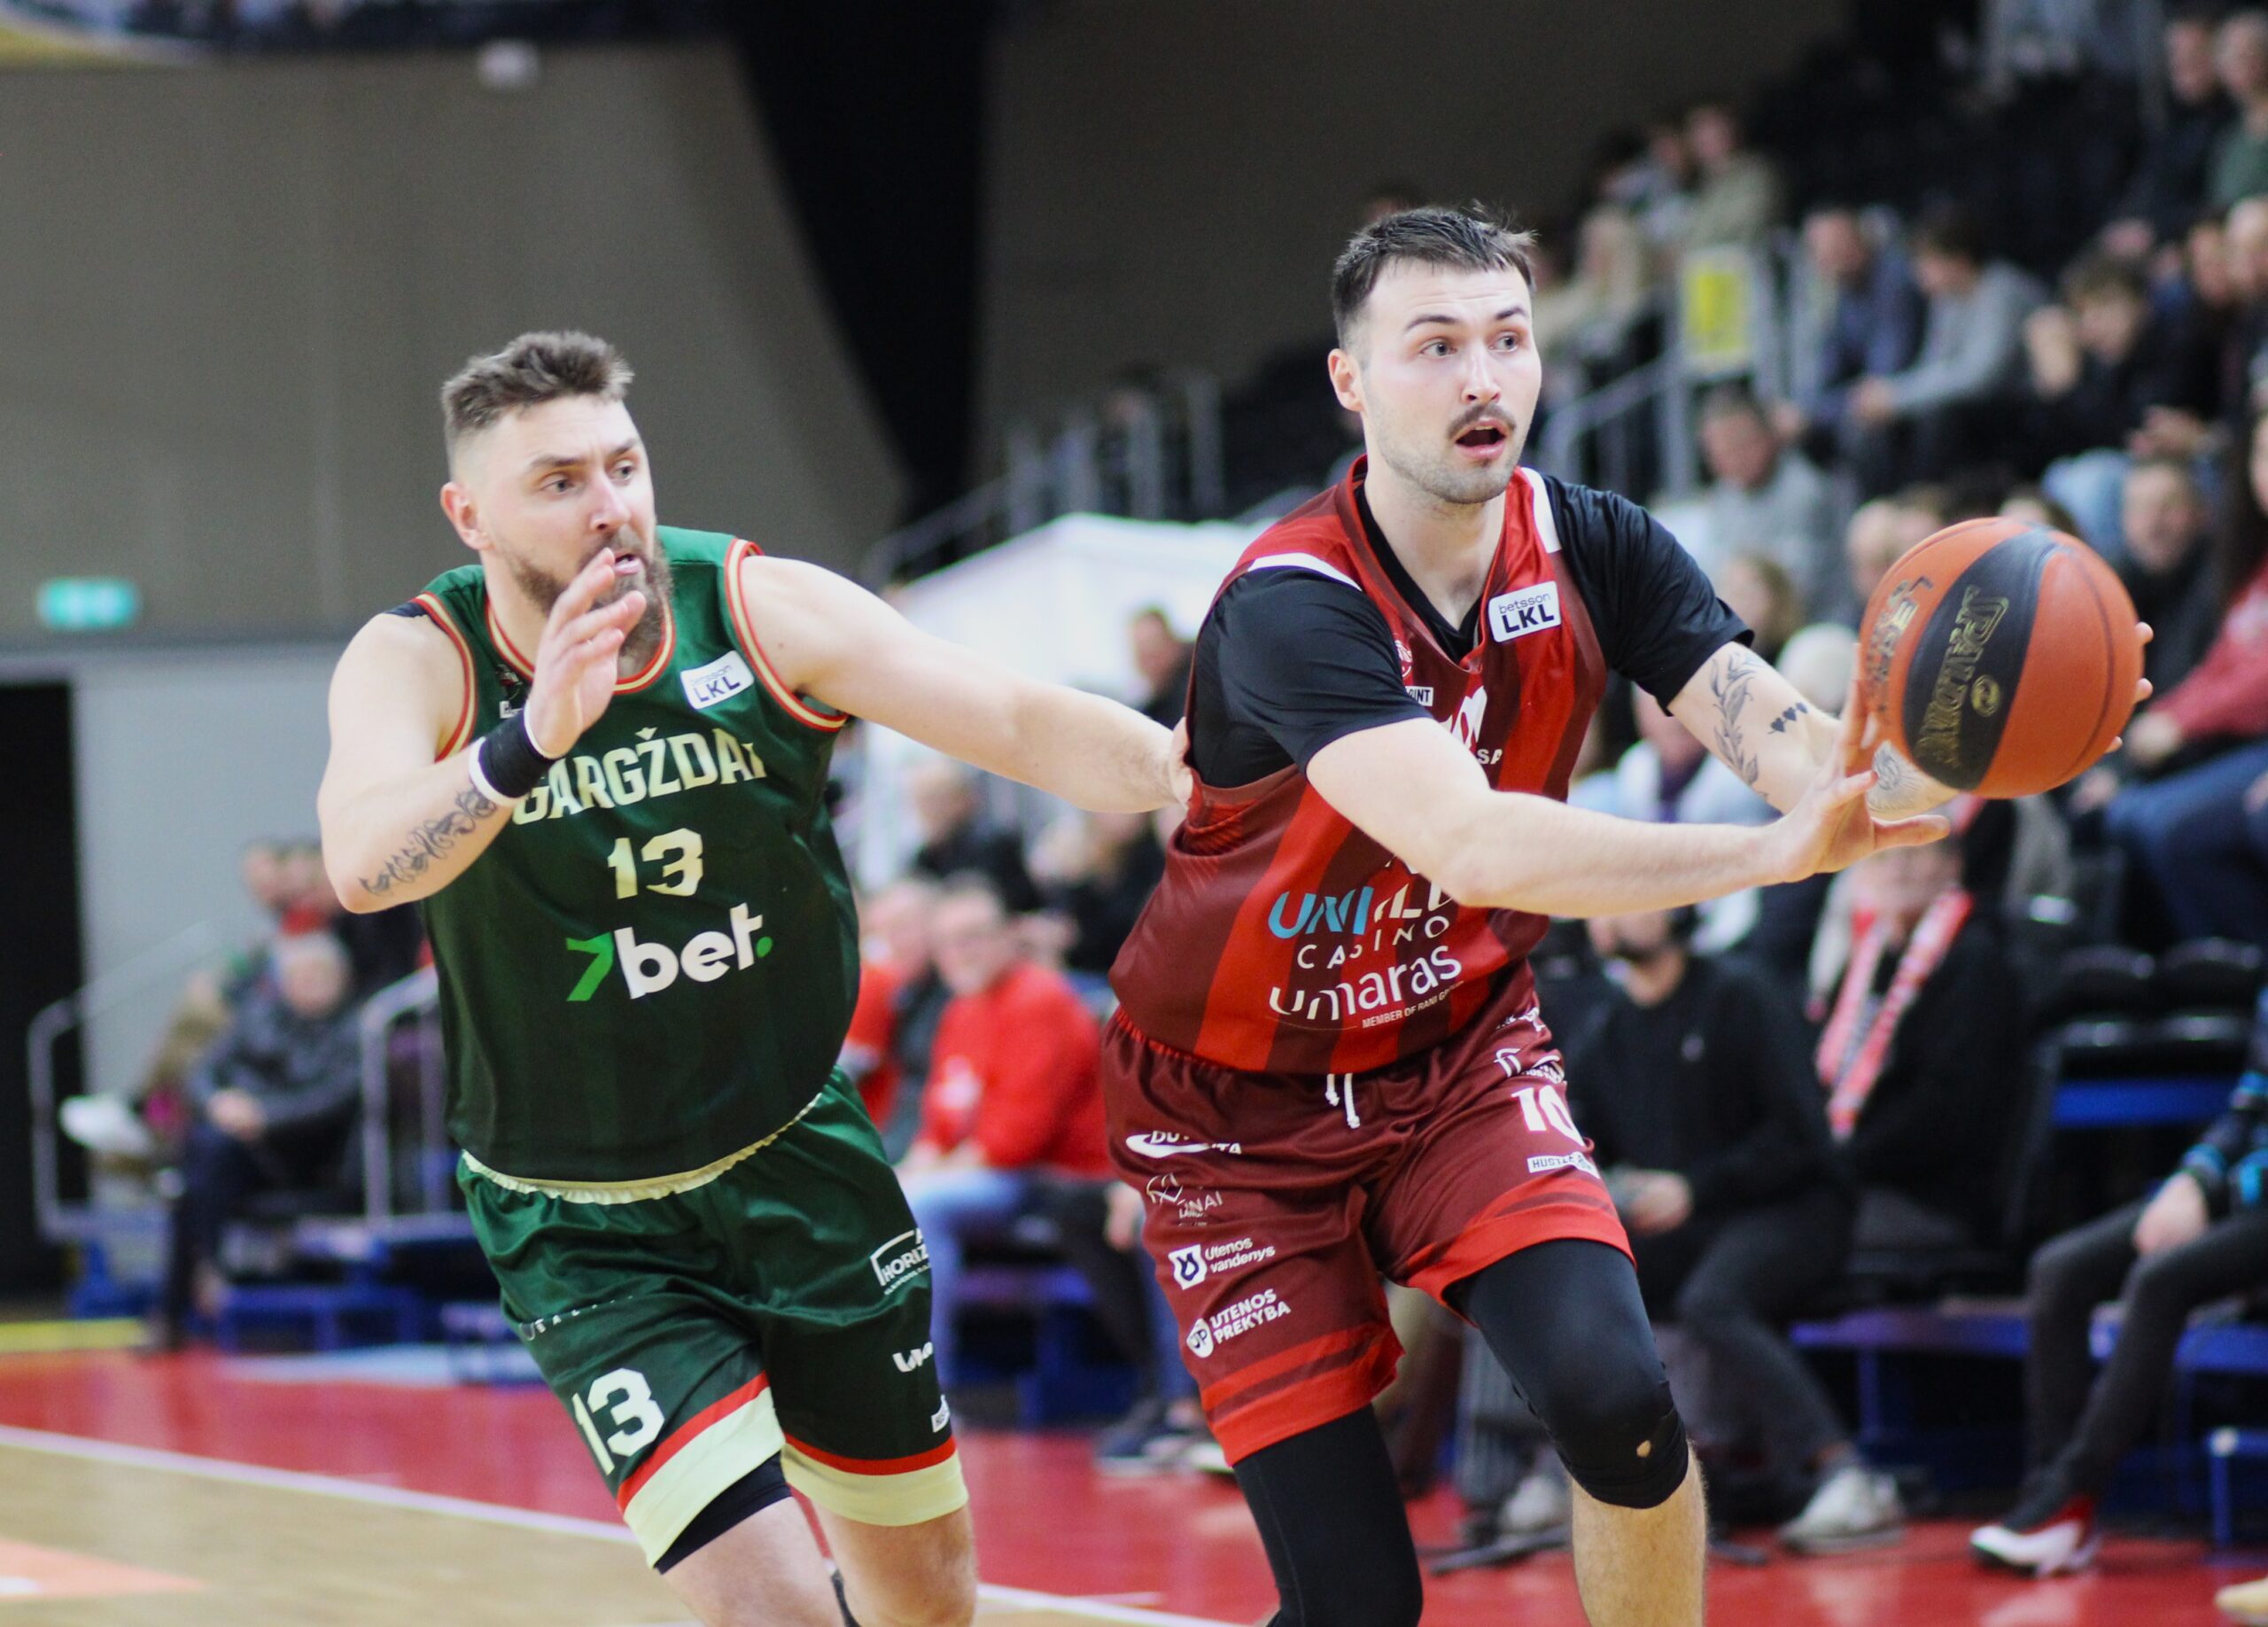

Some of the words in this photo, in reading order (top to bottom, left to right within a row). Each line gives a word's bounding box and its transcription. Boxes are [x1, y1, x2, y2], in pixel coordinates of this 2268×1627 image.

[1498, 593, 1551, 614] betsson
[1502, 603, 1555, 633] LKL
[693, 676, 742, 702] LKL
[607, 828, 703, 899] 13
[1511, 1085, 1586, 1148] 10
[1205, 1237, 1254, 1260] Utenos
[1210, 1246, 1276, 1273] vandenys
[1209, 1288, 1277, 1328] UTENOS
[1213, 1300, 1292, 1344] PREKYBA
[571, 1367, 665, 1475] 13
